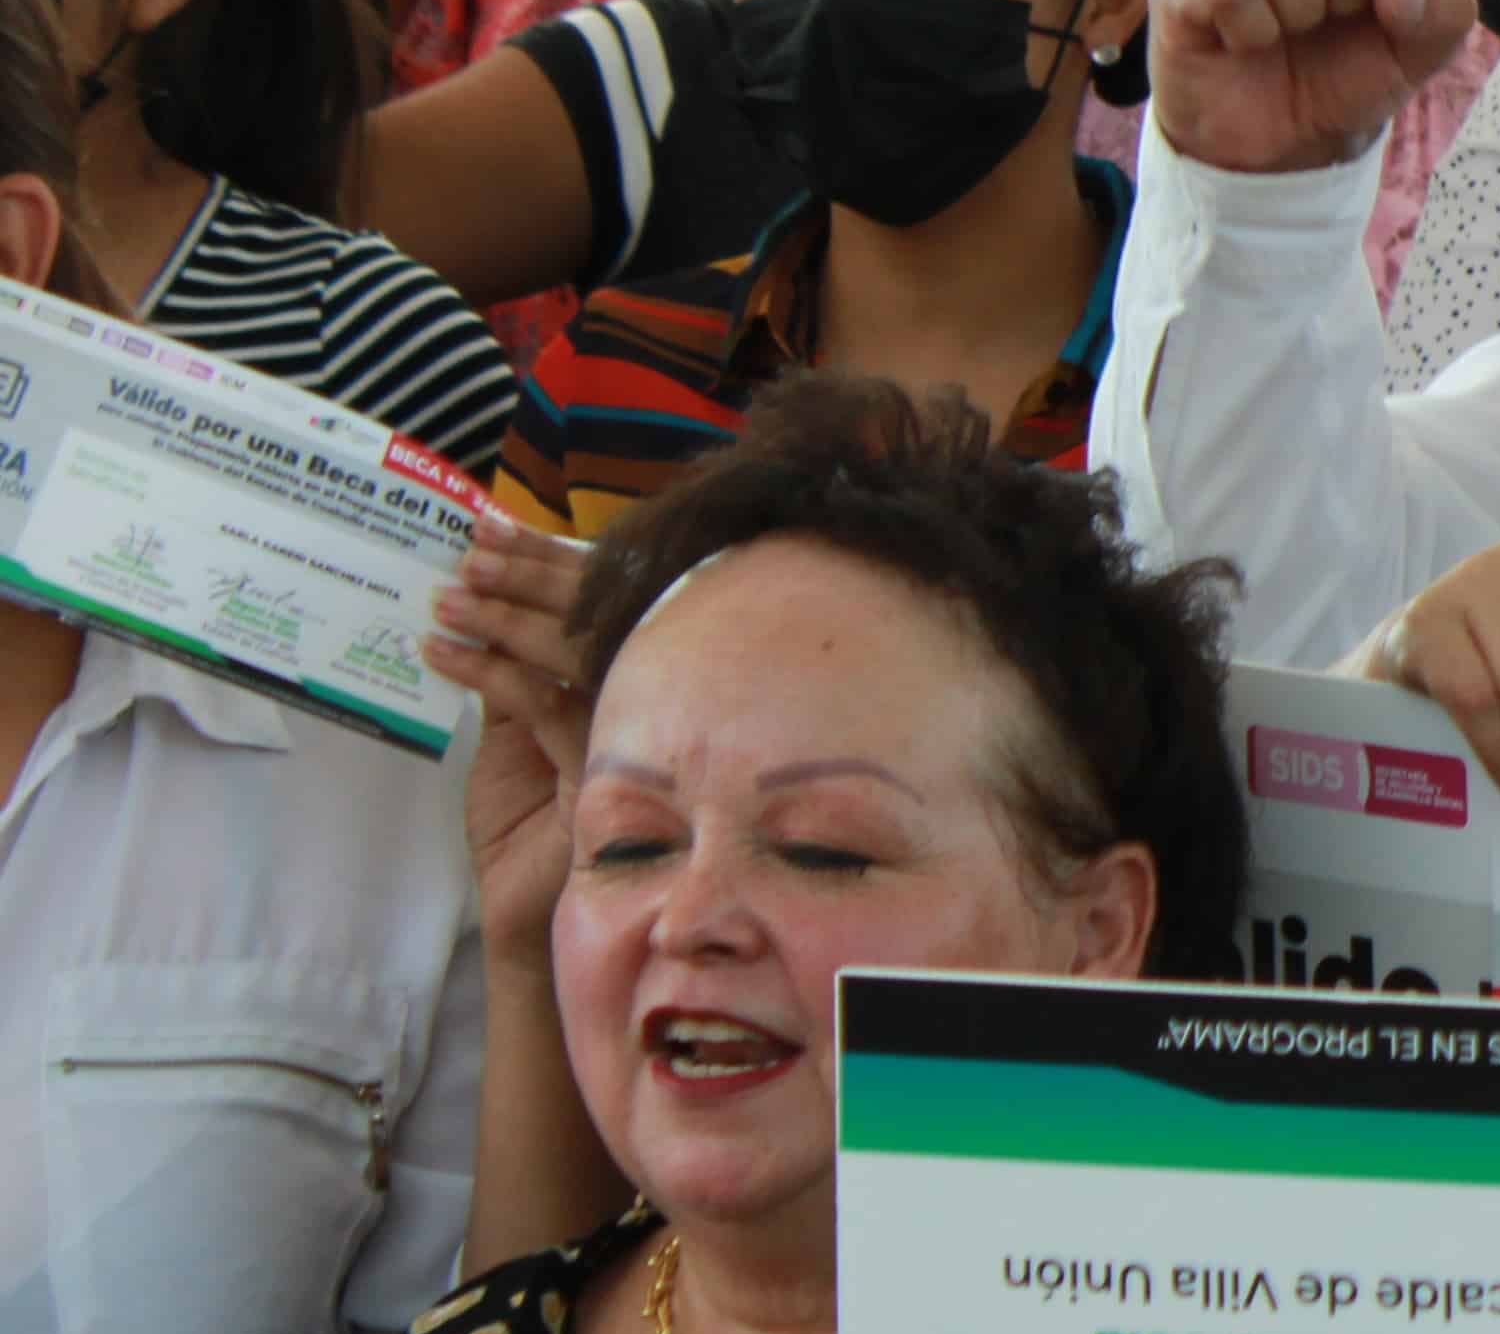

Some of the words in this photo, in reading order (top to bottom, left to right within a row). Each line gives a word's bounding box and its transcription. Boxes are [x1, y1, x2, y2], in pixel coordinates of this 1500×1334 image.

[109, 377, 187, 423] Válido
[193, 412, 242, 444] por
[248, 432, 299, 465] una
[308, 452, 377, 498] Beca
[384, 486, 431, 519] del
[1379, 1027, 1422, 1061] EL
[1431, 1031, 1480, 1064] EN
[1004, 1257, 1152, 1303] Unión
[1172, 1266, 1278, 1312] Villa
[1295, 1273, 1359, 1316] de
